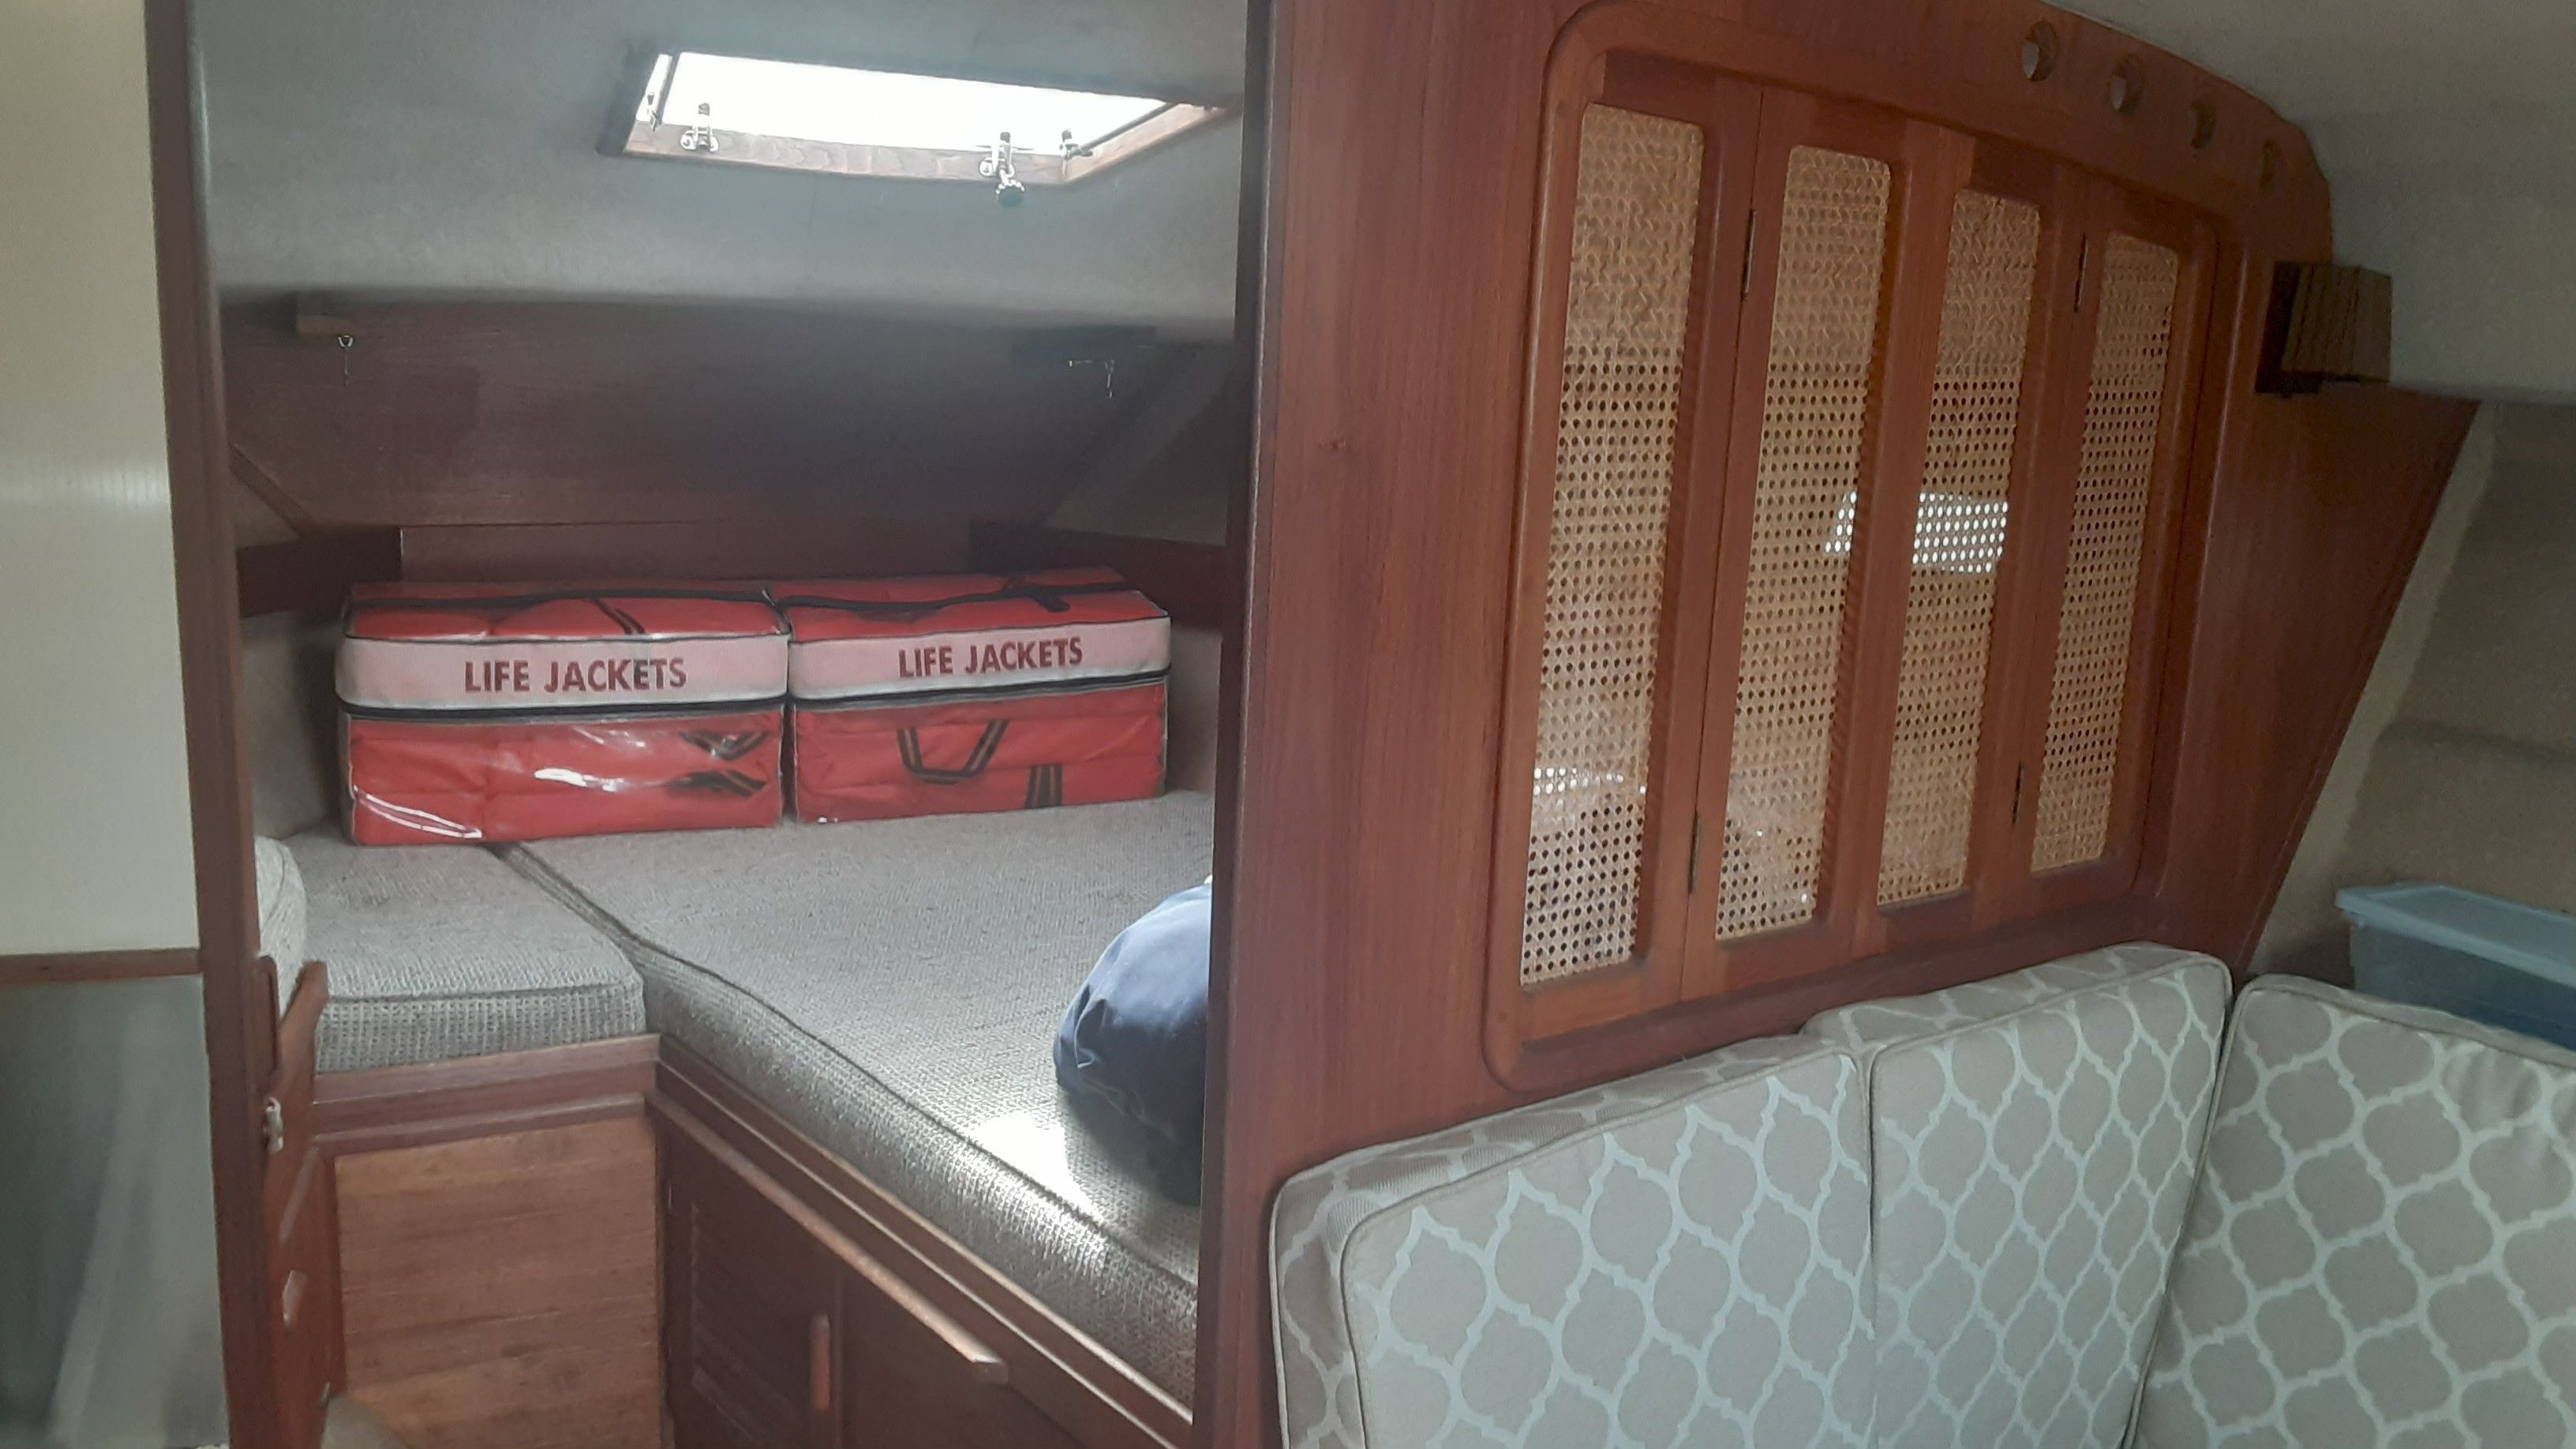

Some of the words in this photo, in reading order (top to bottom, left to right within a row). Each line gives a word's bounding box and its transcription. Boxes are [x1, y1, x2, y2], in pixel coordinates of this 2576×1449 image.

[464, 661, 530, 693] LIFE
[544, 657, 687, 693] JACKETS
[898, 645, 953, 679] LIFE
[964, 636, 1084, 675] JACKETS
